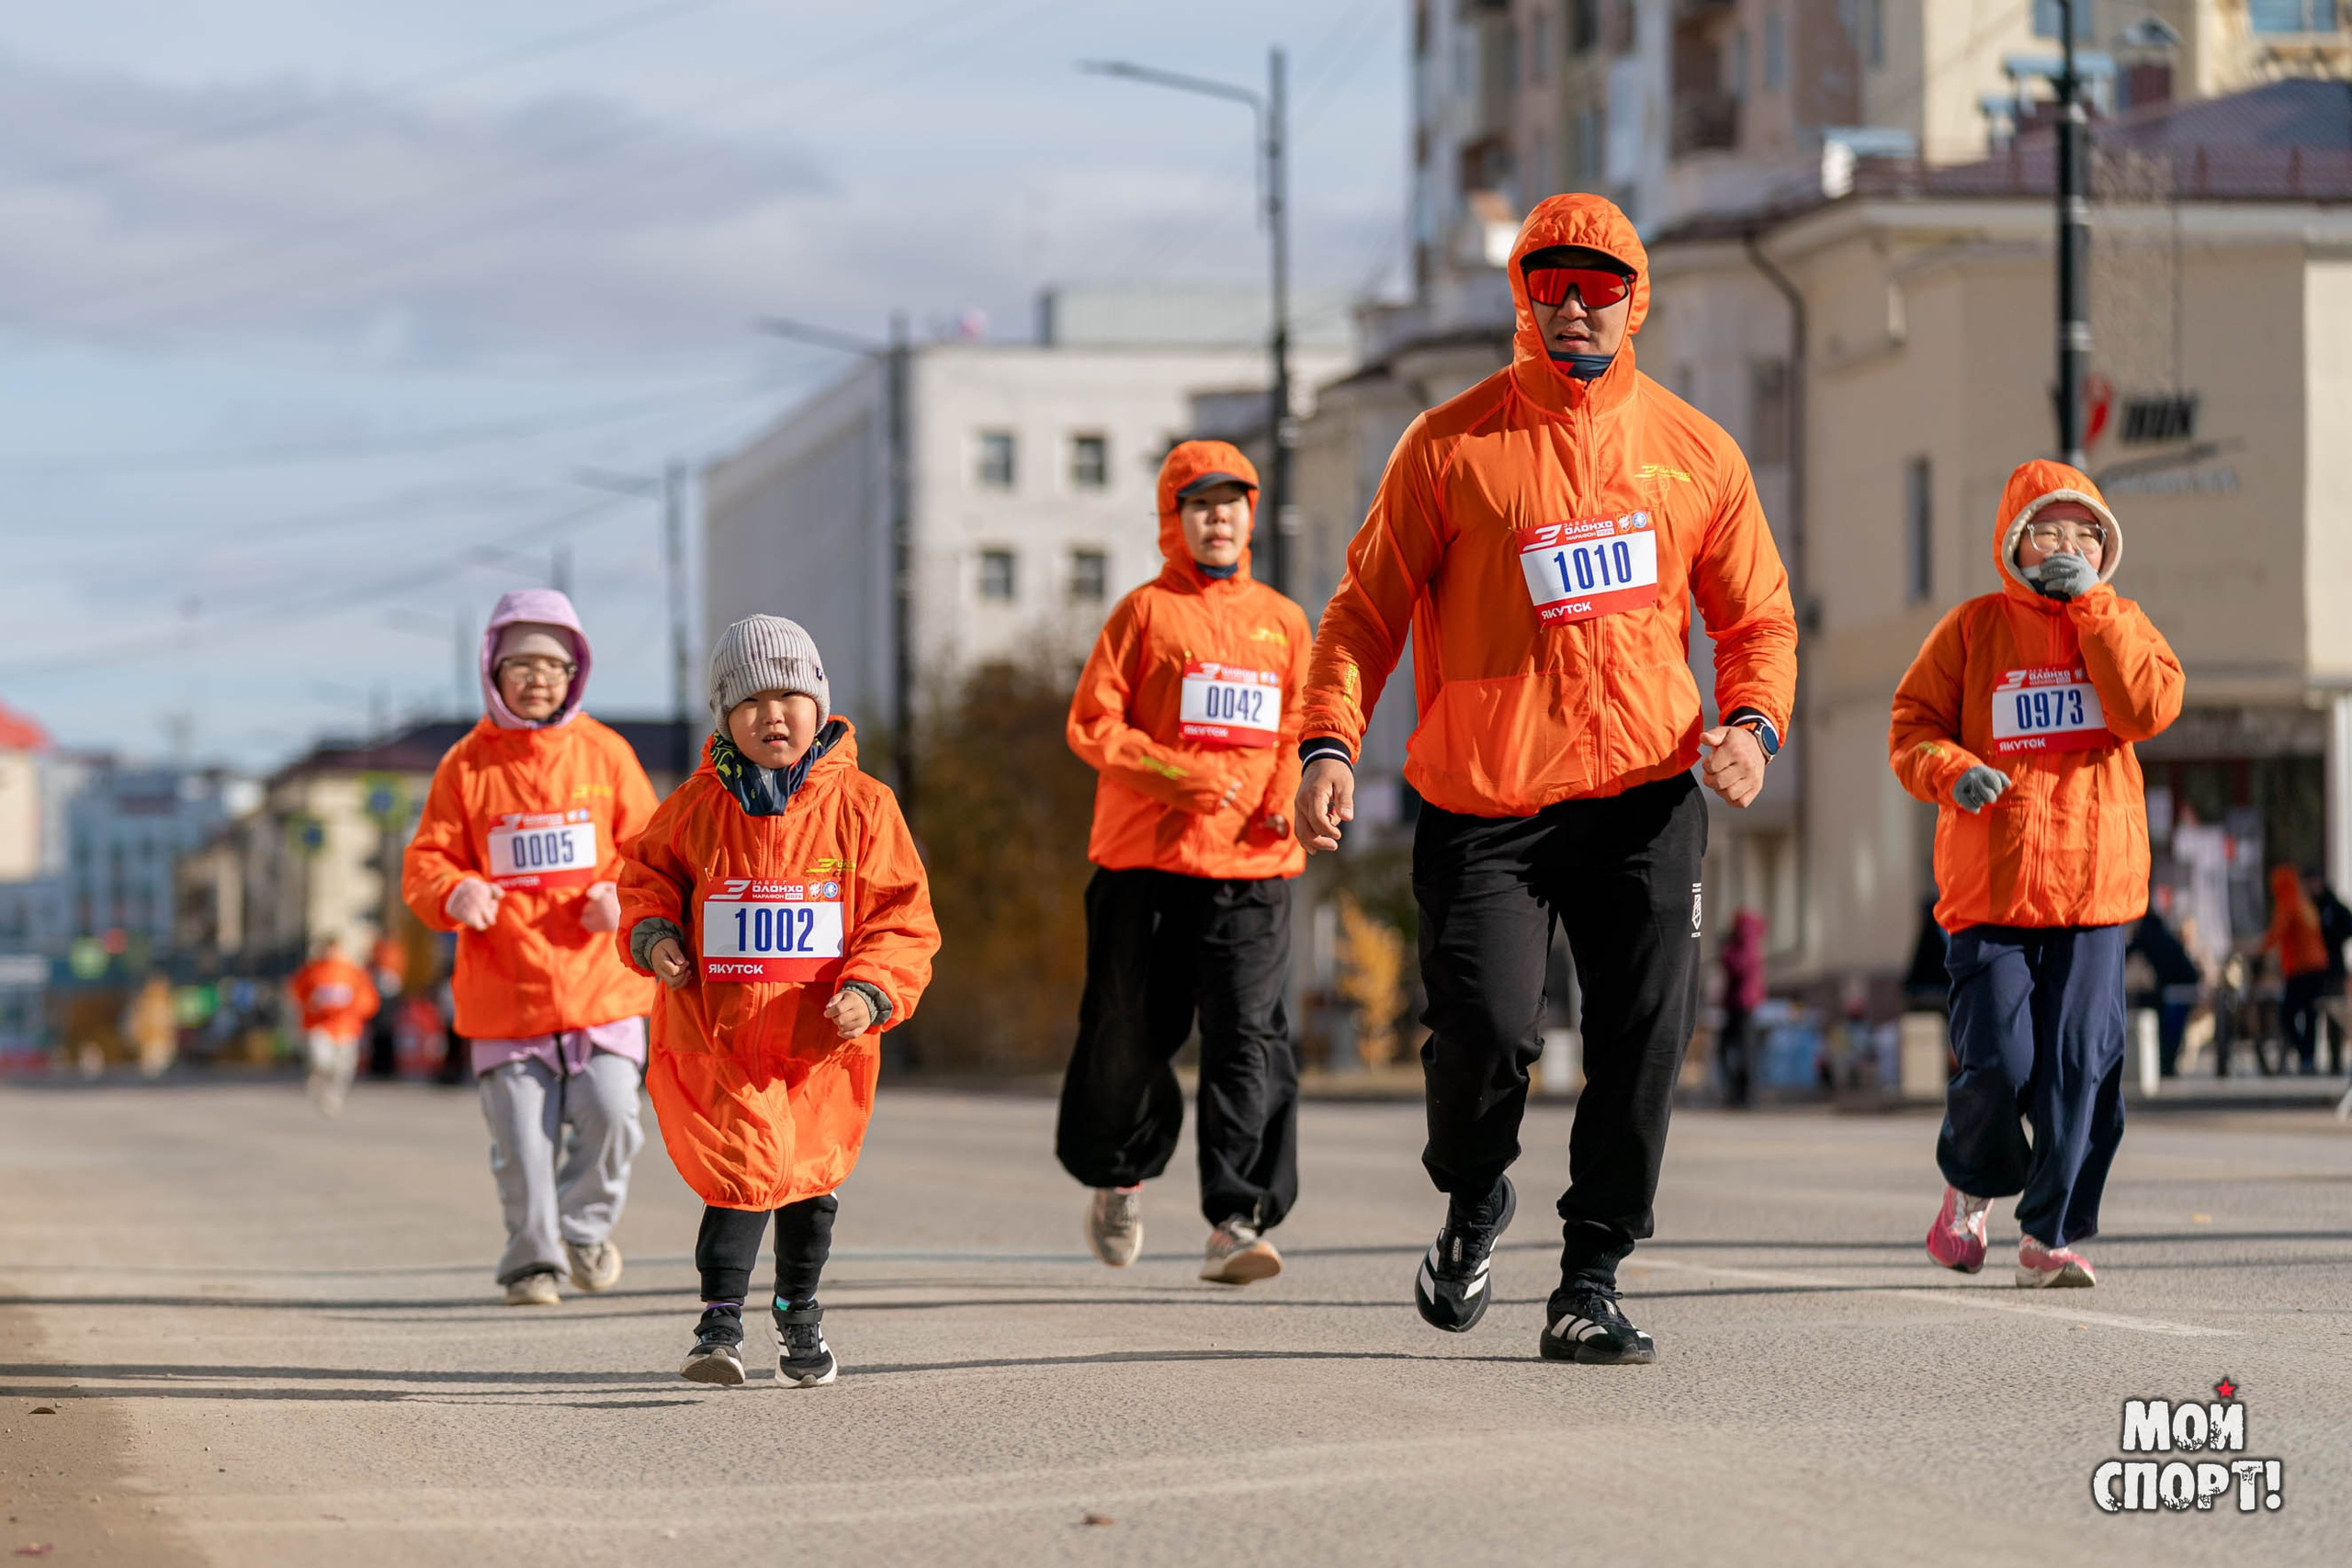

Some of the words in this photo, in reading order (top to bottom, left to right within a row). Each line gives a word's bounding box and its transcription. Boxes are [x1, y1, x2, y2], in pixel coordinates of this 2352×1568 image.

[1564, 518, 1596, 528] ЗАБЕГ
[1564, 520, 1613, 535] ОЛОНХО
[1566, 532, 1597, 541] МАРАФОН
[1553, 541, 1632, 593] 1010
[1541, 601, 1592, 620] ЯКУТСК
[1206, 685, 1262, 722] 0042
[2016, 689, 2084, 730] 0973
[1998, 738, 2046, 752] ЯКУТСК
[512, 830, 573, 868] 0005
[752, 885, 804, 893] ОЛОНХО
[735, 908, 814, 952] 1002
[708, 964, 764, 975] ЯКУТСК
